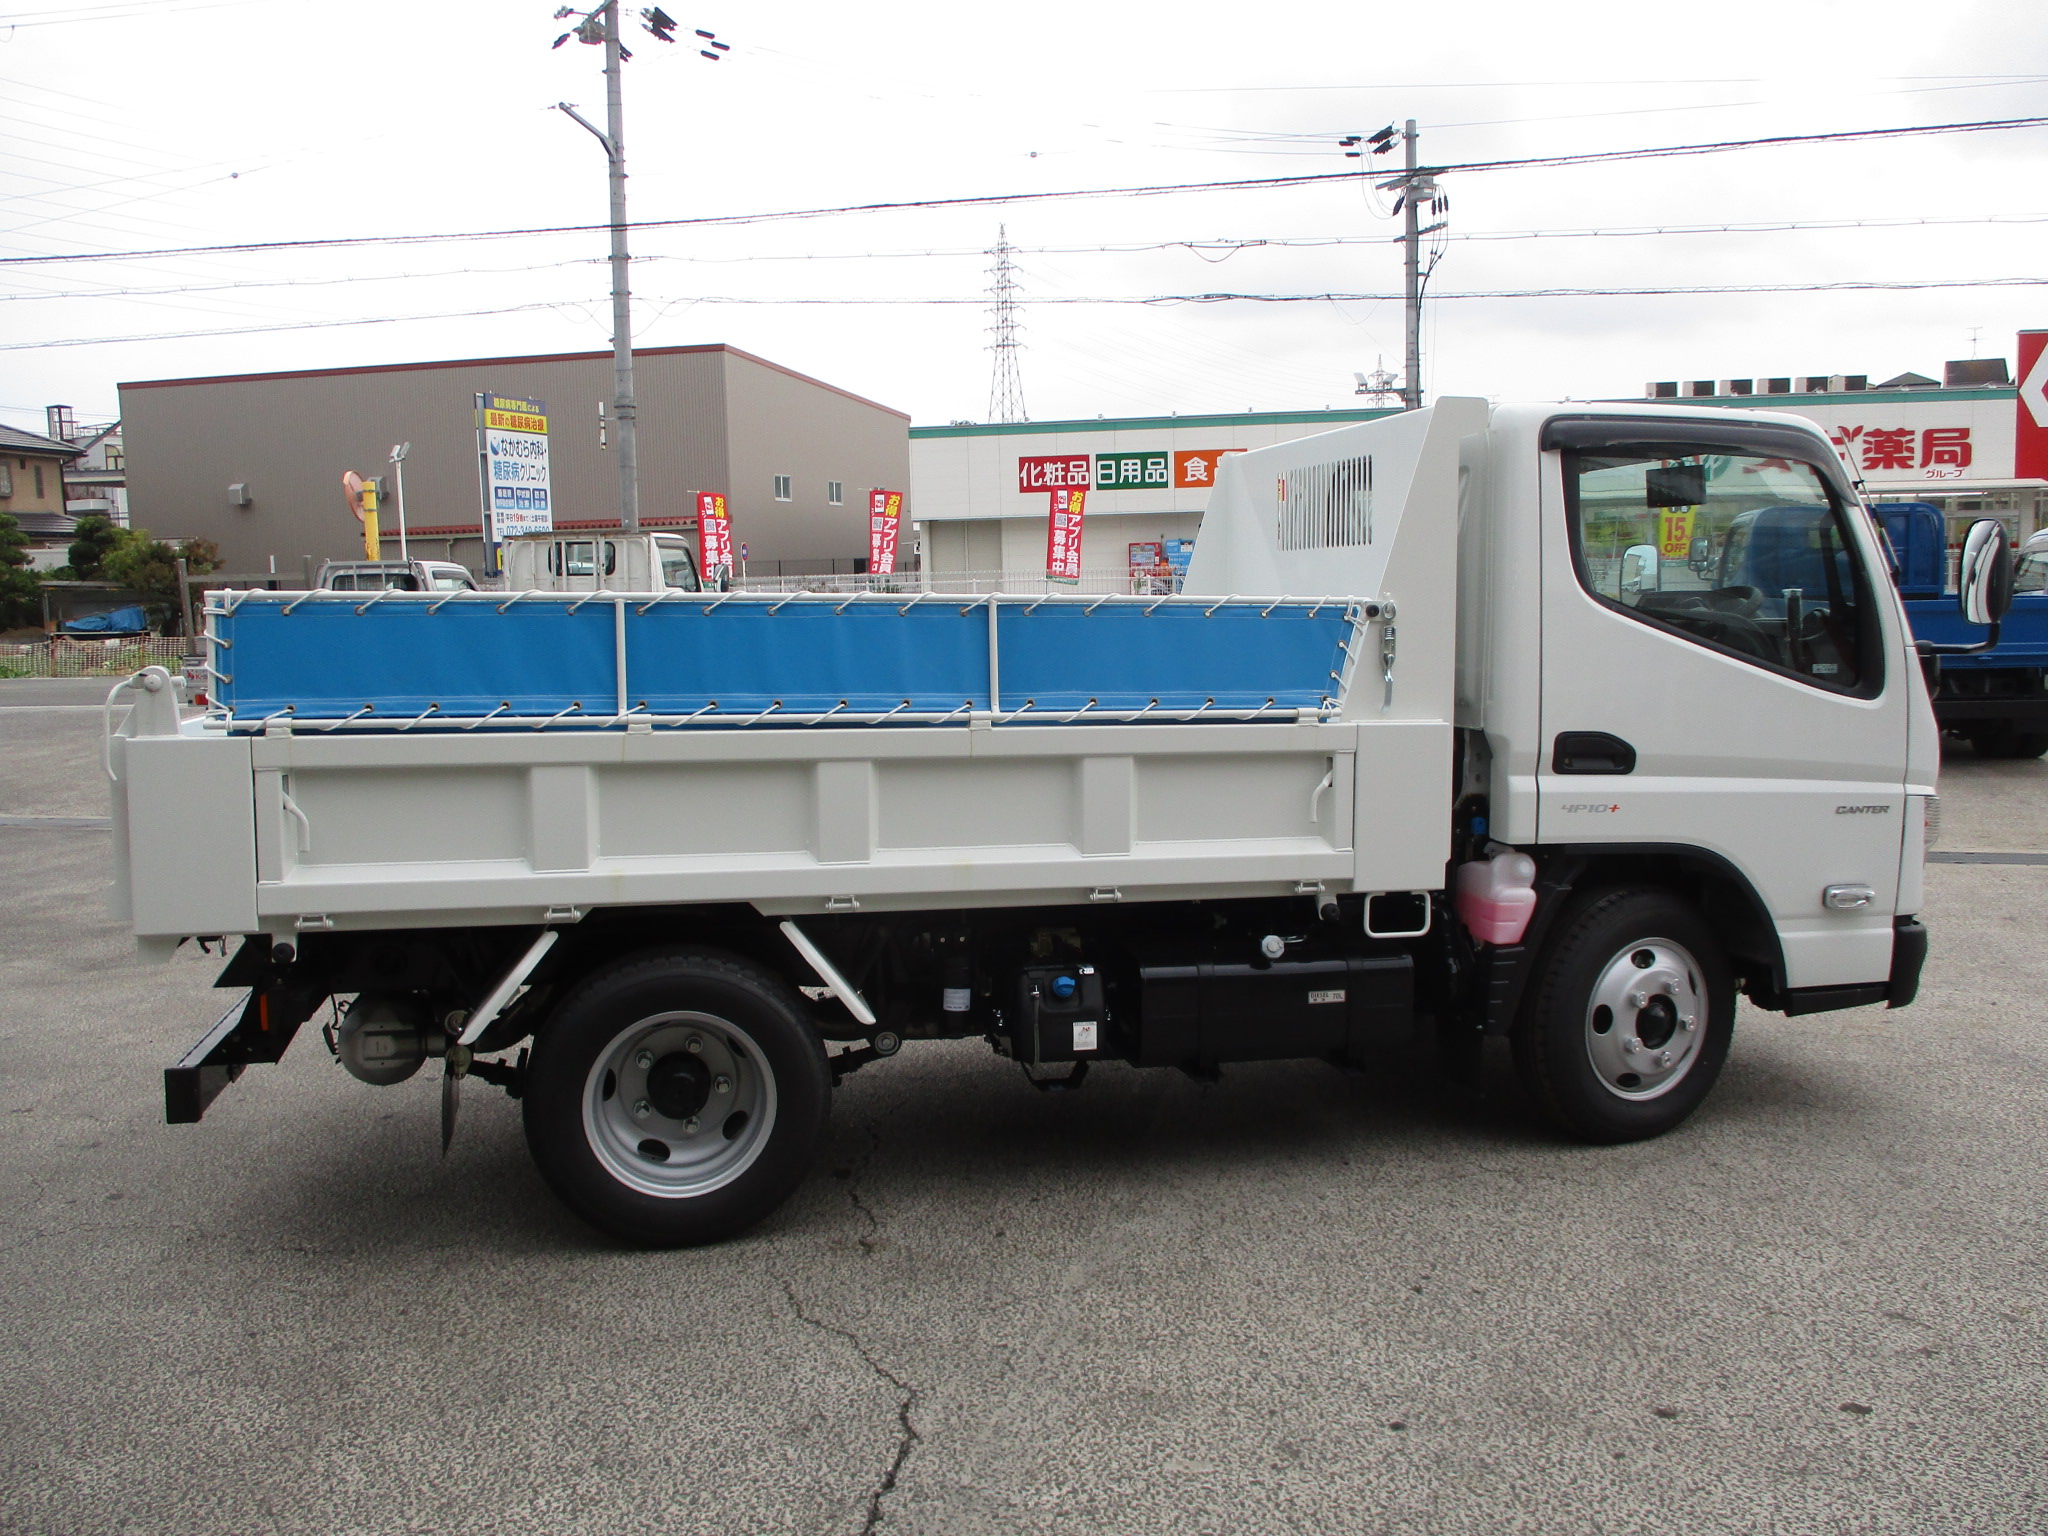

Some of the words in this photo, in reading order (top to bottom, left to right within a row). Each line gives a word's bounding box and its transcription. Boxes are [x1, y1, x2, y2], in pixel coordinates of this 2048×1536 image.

[494, 460, 547, 482] 糖尿病クリニック
[1020, 461, 1089, 487] 化粧品
[1097, 458, 1167, 484] 日用品
[1925, 468, 1965, 478] グループ
[1052, 529, 1067, 574] 募集中
[1664, 543, 1687, 553] OFF
